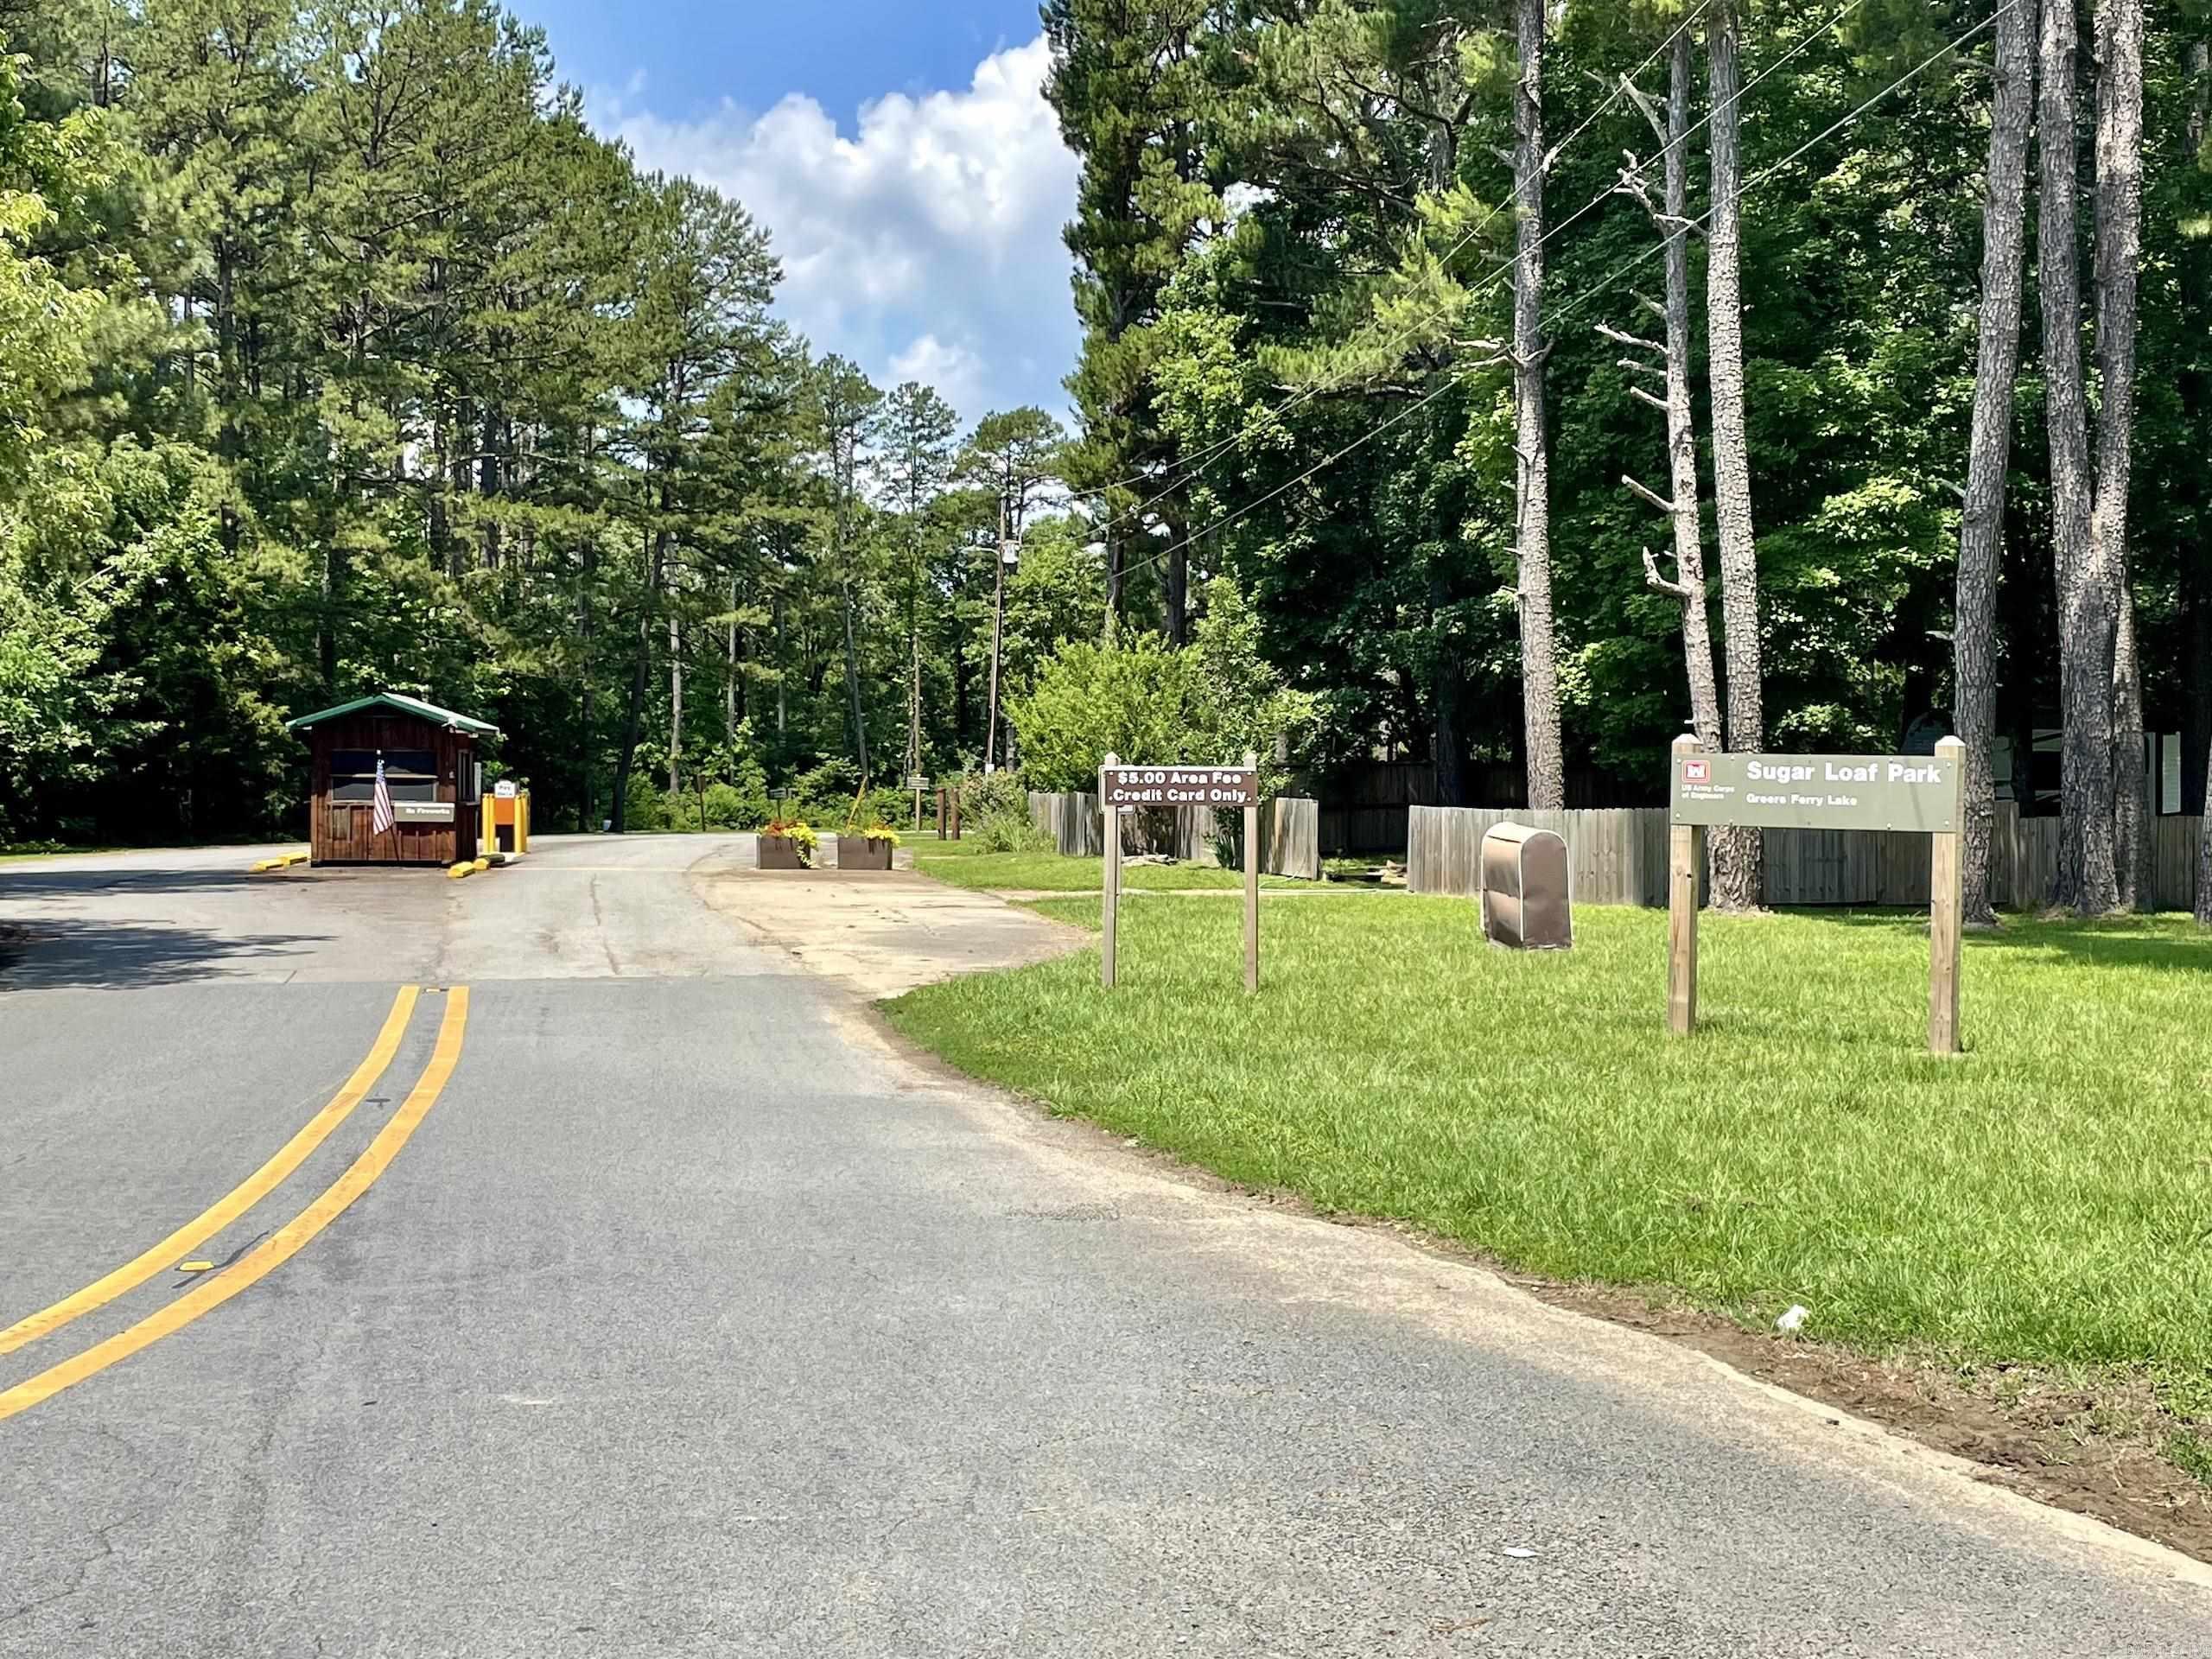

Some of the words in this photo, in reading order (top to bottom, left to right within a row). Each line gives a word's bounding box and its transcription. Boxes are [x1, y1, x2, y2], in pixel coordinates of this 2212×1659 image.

[1118, 771, 1166, 785] $5.00
[1170, 772, 1209, 785] Area
[1212, 772, 1242, 785] Fee
[1746, 760, 1815, 784] Sugar
[1825, 762, 1878, 782] Loaf
[1888, 763, 1942, 783] Park
[1693, 785, 1712, 793] Army
[1713, 785, 1735, 793] Corps
[1113, 789, 1163, 802] Credit
[1166, 789, 1205, 802] Card
[1210, 789, 1247, 804] Only
[1790, 794, 1823, 807] Ferry
[1827, 795, 1858, 805] Lake
